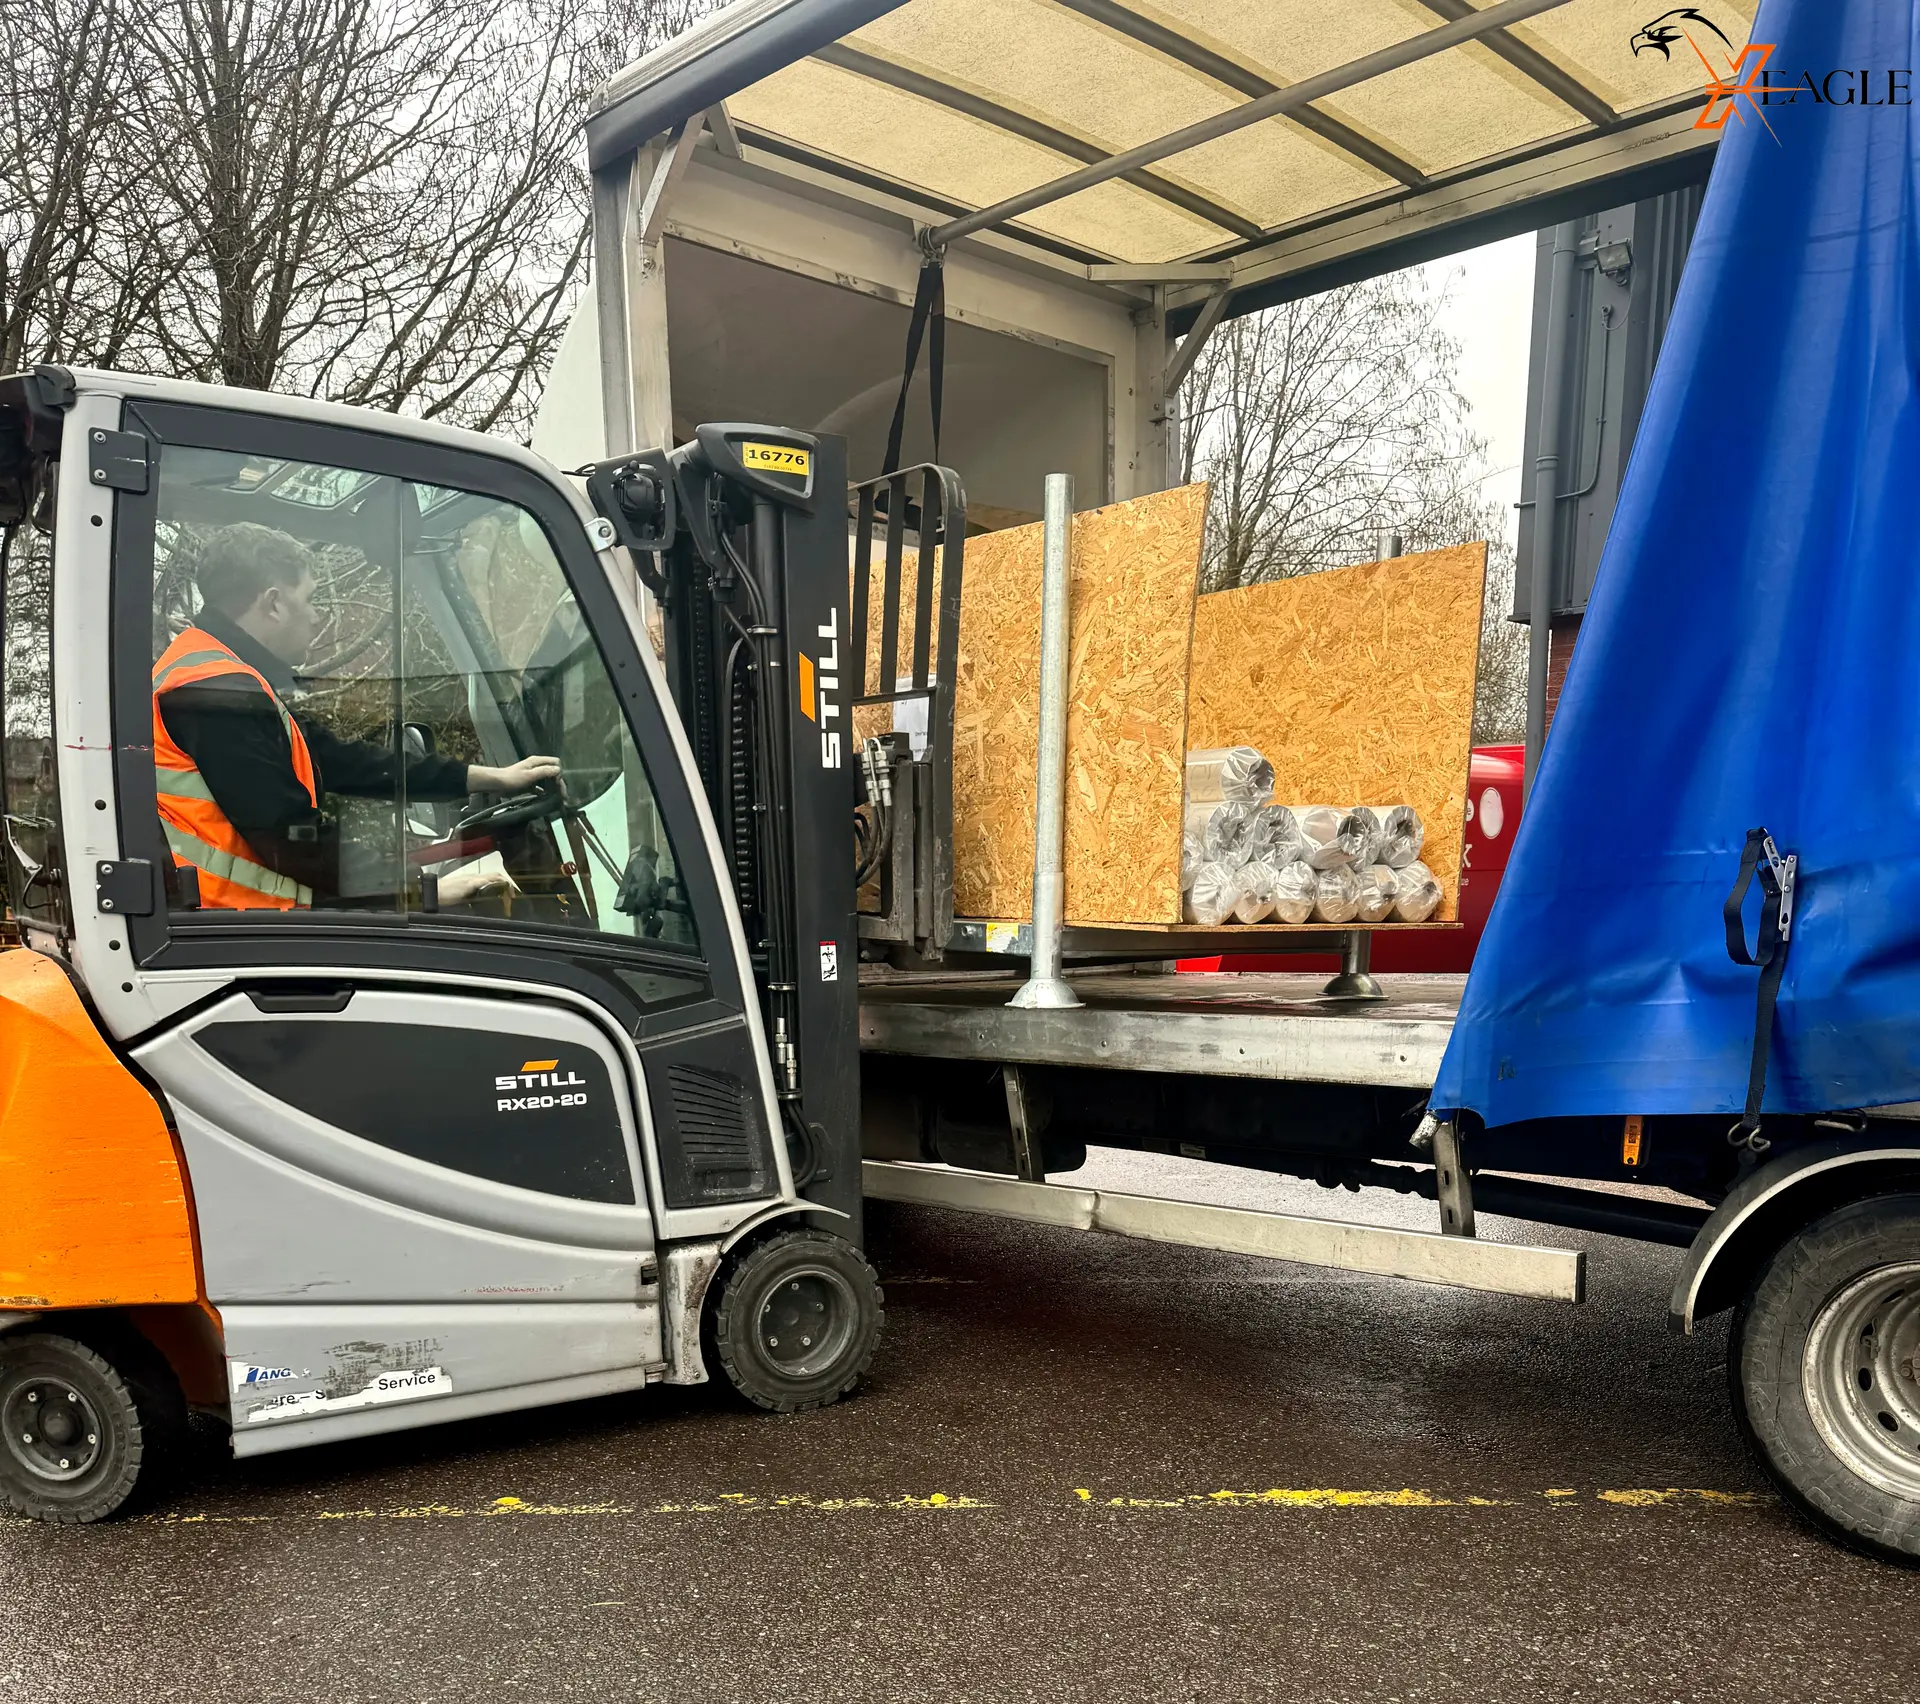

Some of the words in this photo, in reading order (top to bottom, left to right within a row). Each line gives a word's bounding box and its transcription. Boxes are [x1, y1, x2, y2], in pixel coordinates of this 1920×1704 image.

[749, 449, 805, 466] 16776
[818, 607, 841, 769] STILL
[495, 1071, 586, 1091] STILL
[497, 1092, 588, 1112] RX20-20
[378, 1374, 436, 1391] Service
